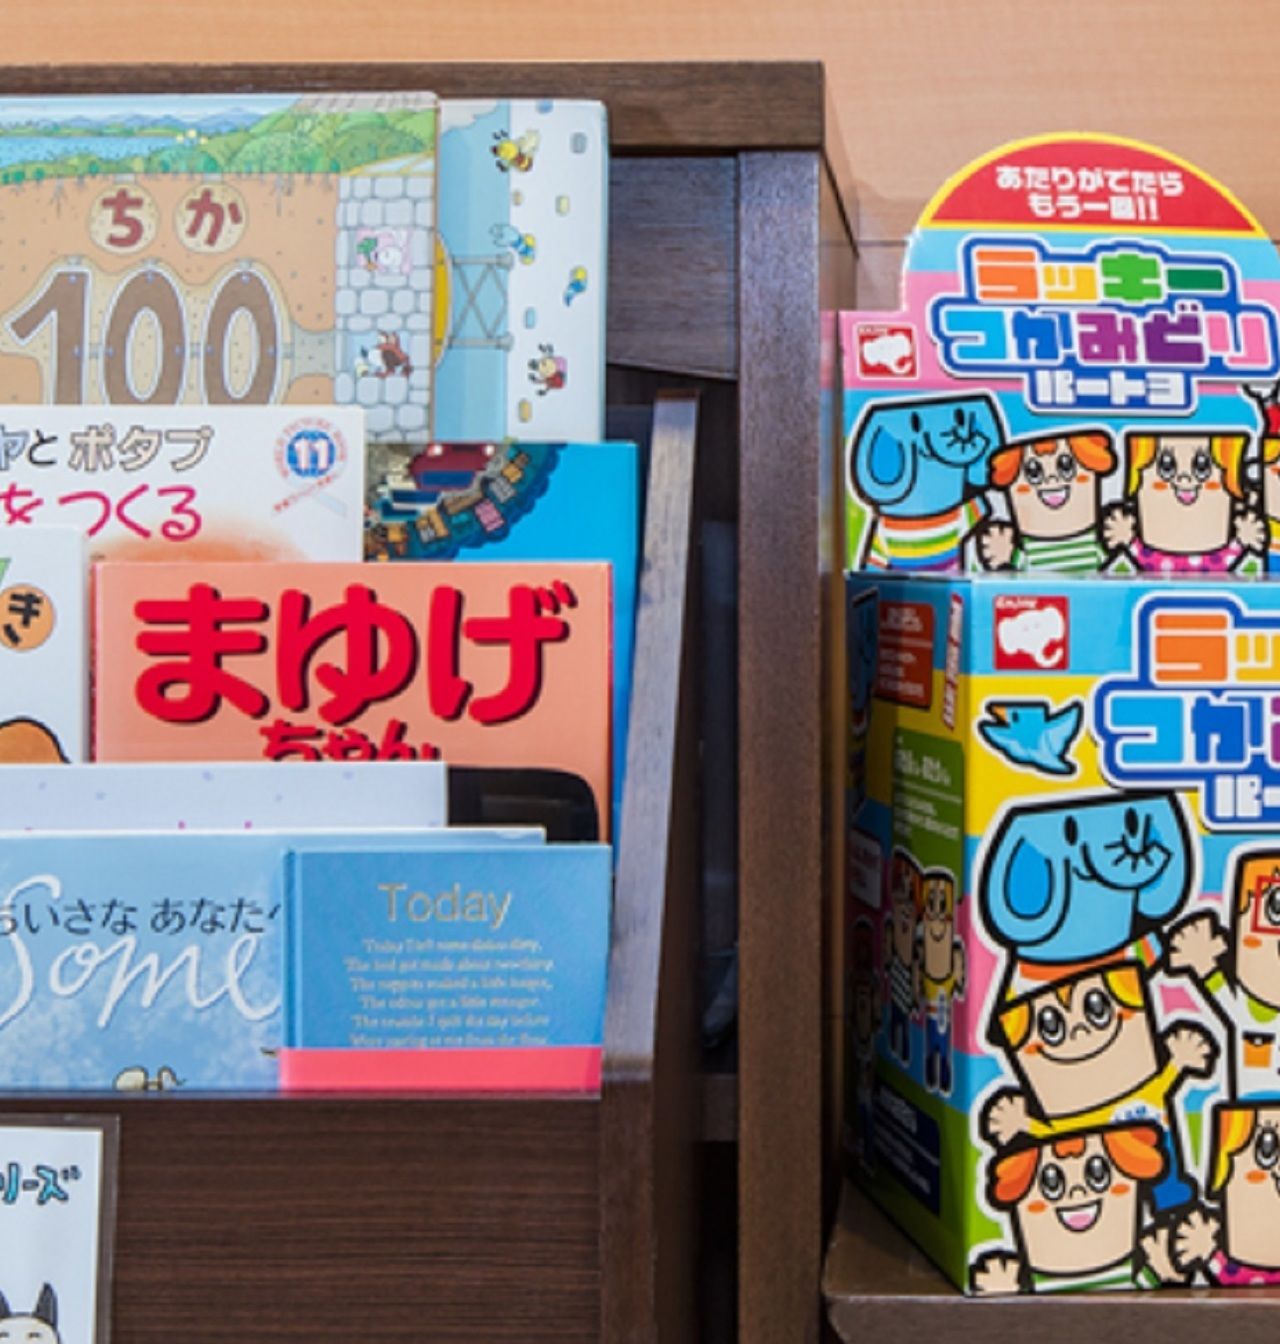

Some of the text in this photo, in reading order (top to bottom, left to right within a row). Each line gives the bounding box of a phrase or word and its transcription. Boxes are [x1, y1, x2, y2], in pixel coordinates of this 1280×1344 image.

[996, 165, 1184, 197] あたりがでたら
[99, 189, 242, 246] ちか
[975, 250, 1225, 302] ラッキー
[9, 271, 280, 403] 100
[946, 301, 1269, 364] つかみどり
[295, 440, 329, 469] 11
[134, 580, 577, 725] まゆげ
[377, 882, 512, 930] Today
